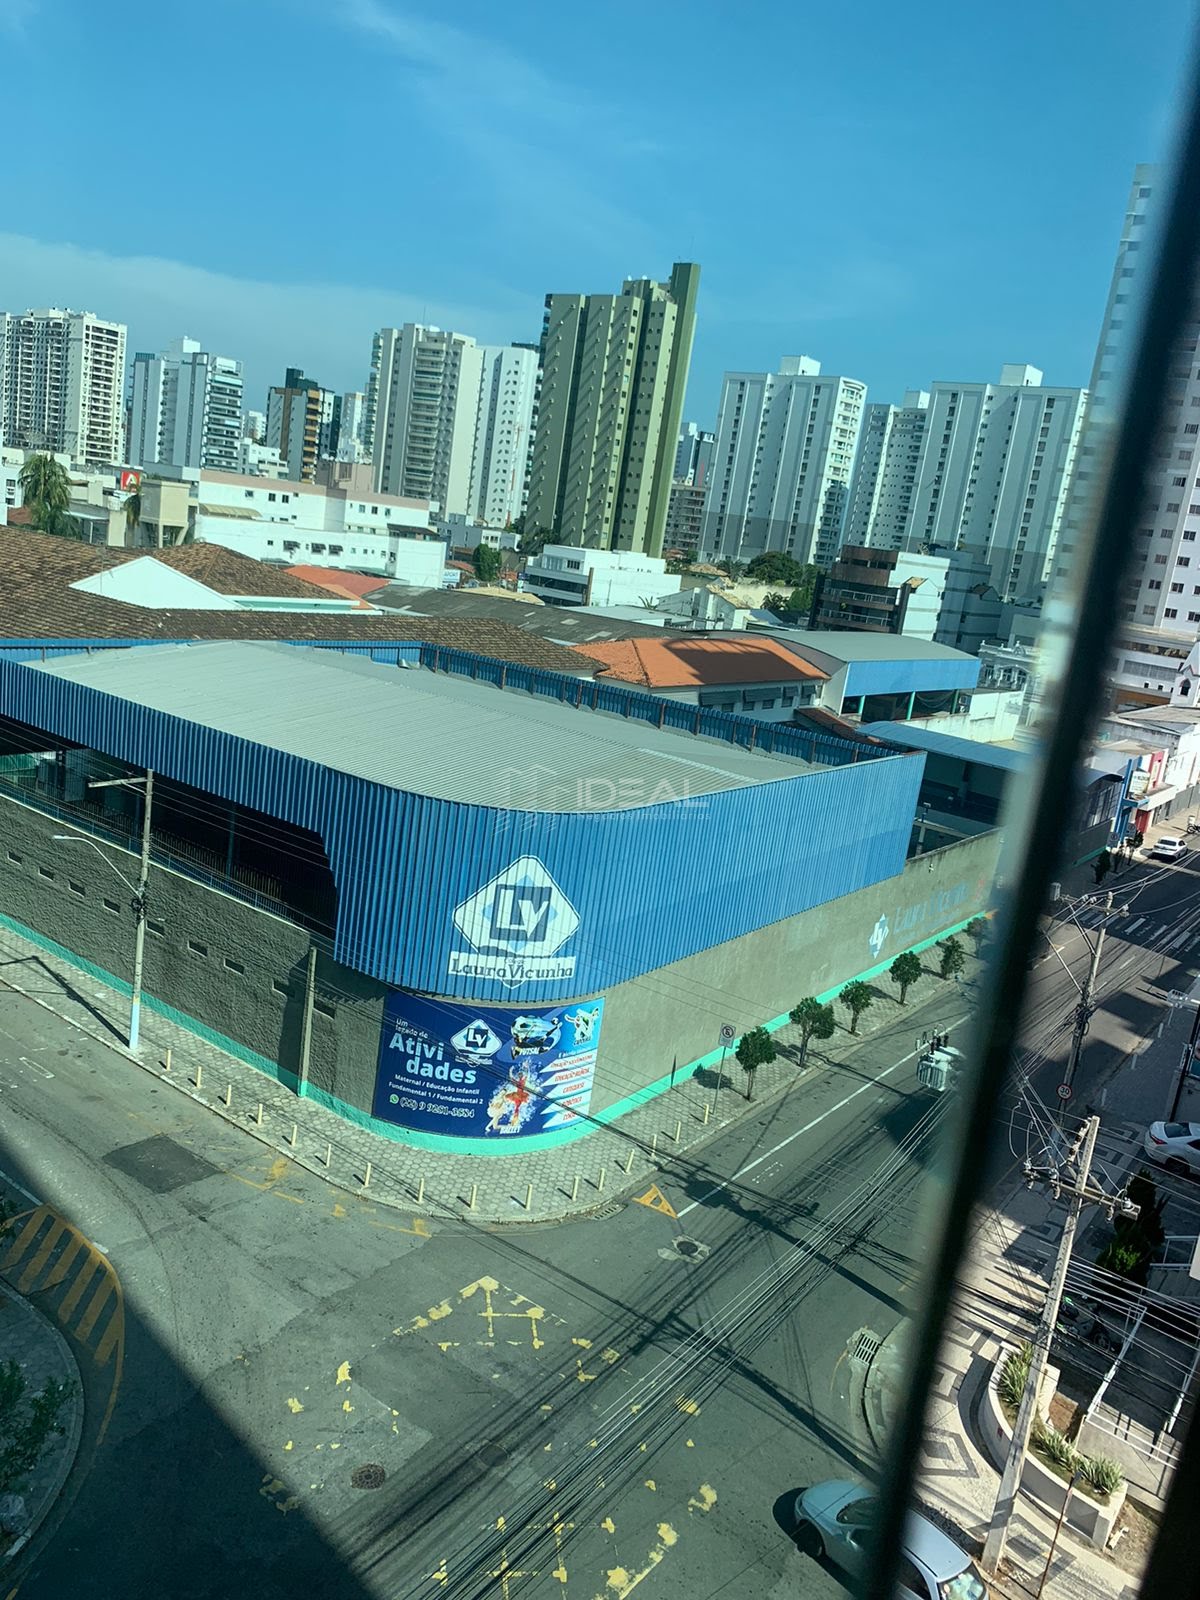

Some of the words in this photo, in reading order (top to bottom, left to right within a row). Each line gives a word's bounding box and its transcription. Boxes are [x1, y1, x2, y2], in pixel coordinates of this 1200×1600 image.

[389, 1032, 444, 1061] Ativi
[406, 1056, 477, 1084] dades
[388, 1081, 427, 1097] Fundamental
[436, 1093, 479, 1104] Fundamental
[395, 1074, 421, 1086] Maternal
[426, 1082, 455, 1092] Educação
[456, 1087, 480, 1095] Infantil
